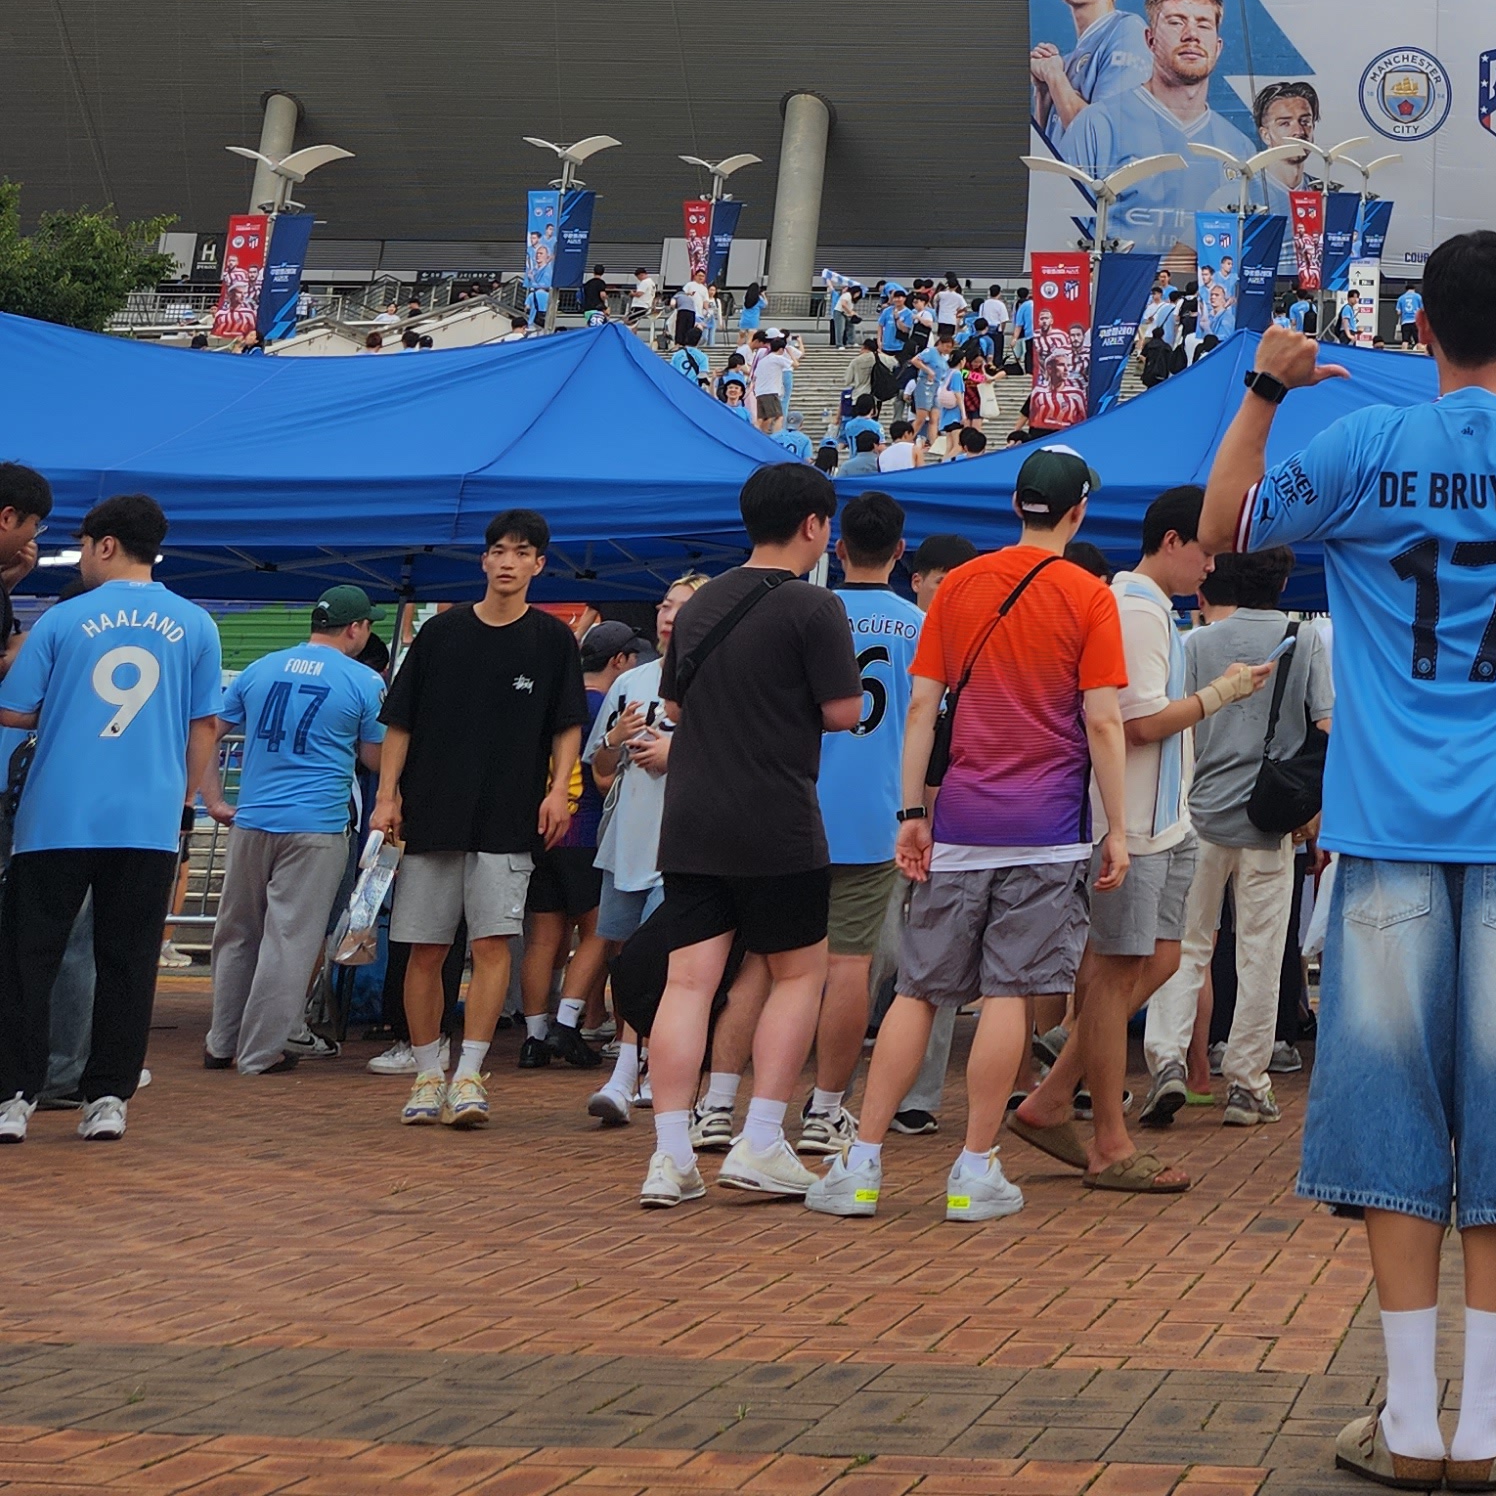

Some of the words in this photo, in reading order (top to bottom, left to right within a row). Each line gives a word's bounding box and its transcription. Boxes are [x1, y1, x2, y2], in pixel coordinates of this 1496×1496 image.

[1370, 54, 1442, 84] MANCHESTER
[1393, 125, 1420, 134] CITY
[202, 244, 216, 261] H
[1379, 471, 1418, 508] DE
[82, 609, 185, 643] HAALAND
[285, 658, 324, 676] FODEN
[92, 645, 160, 738] 9
[257, 681, 331, 755] 47
